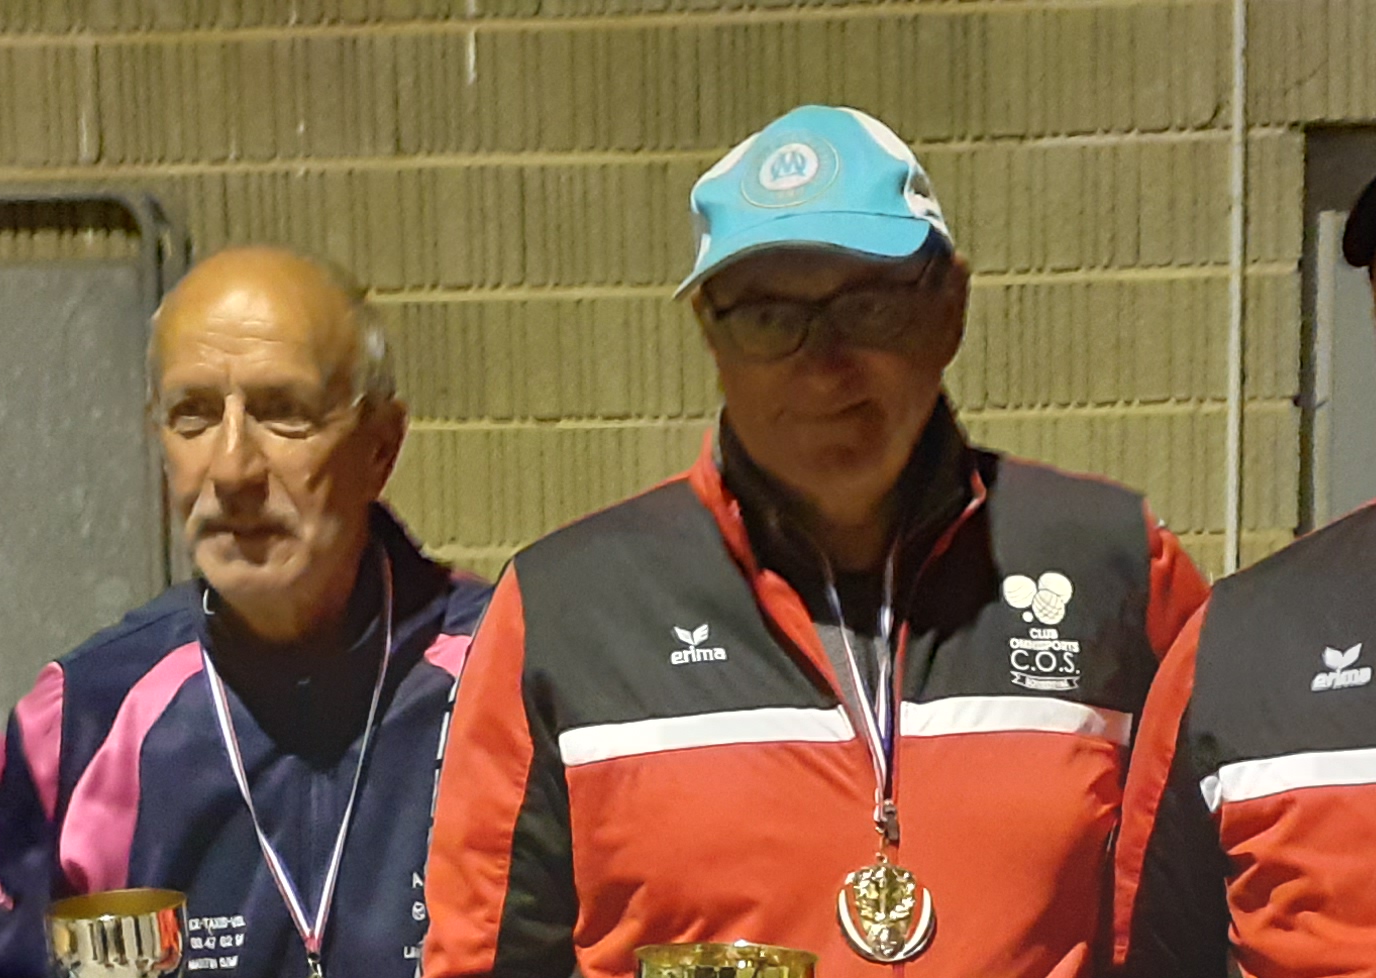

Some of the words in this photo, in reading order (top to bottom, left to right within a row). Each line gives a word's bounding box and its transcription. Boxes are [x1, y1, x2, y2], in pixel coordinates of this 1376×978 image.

[1029, 627, 1059, 640] CLUB
[670, 645, 728, 665] erima
[1010, 649, 1081, 674] C.O.S.
[1310, 666, 1372, 692] erima
